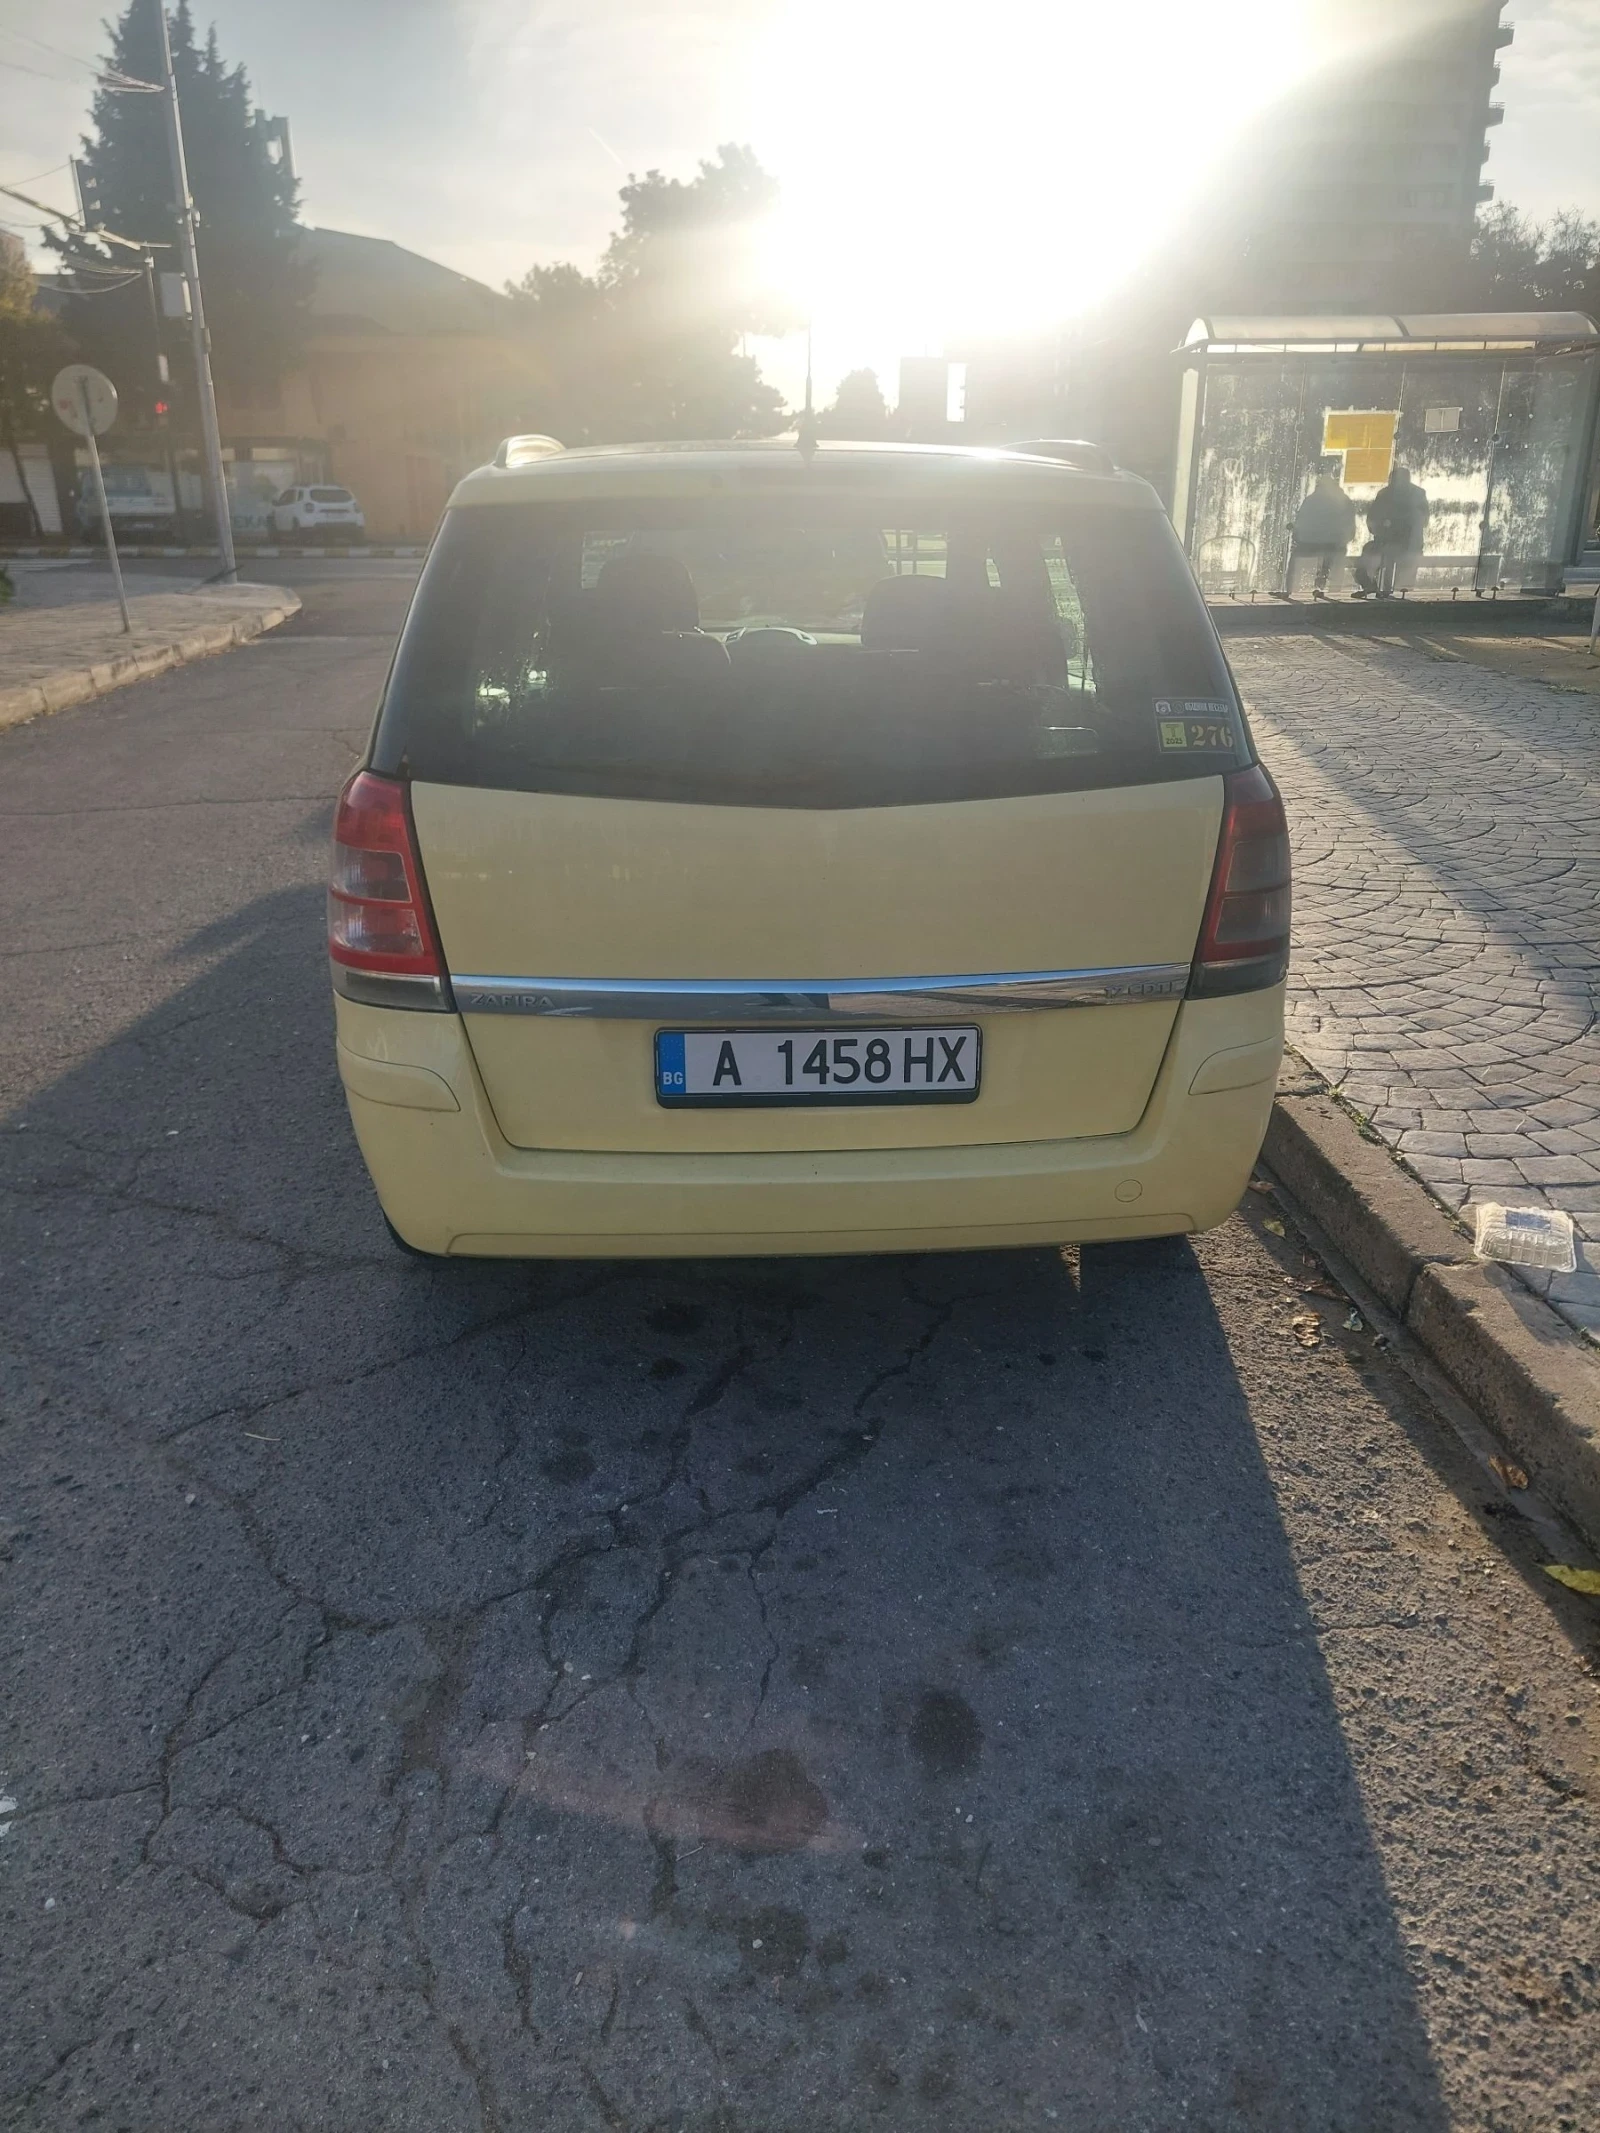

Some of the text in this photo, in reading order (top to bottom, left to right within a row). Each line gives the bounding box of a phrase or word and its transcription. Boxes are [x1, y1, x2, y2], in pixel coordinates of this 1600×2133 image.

[1191, 725, 1233, 748] 276
[470, 993, 556, 1008] ZAFIRA
[712, 1036, 967, 1086] A 1458 HX
[663, 1071, 683, 1085] BG
